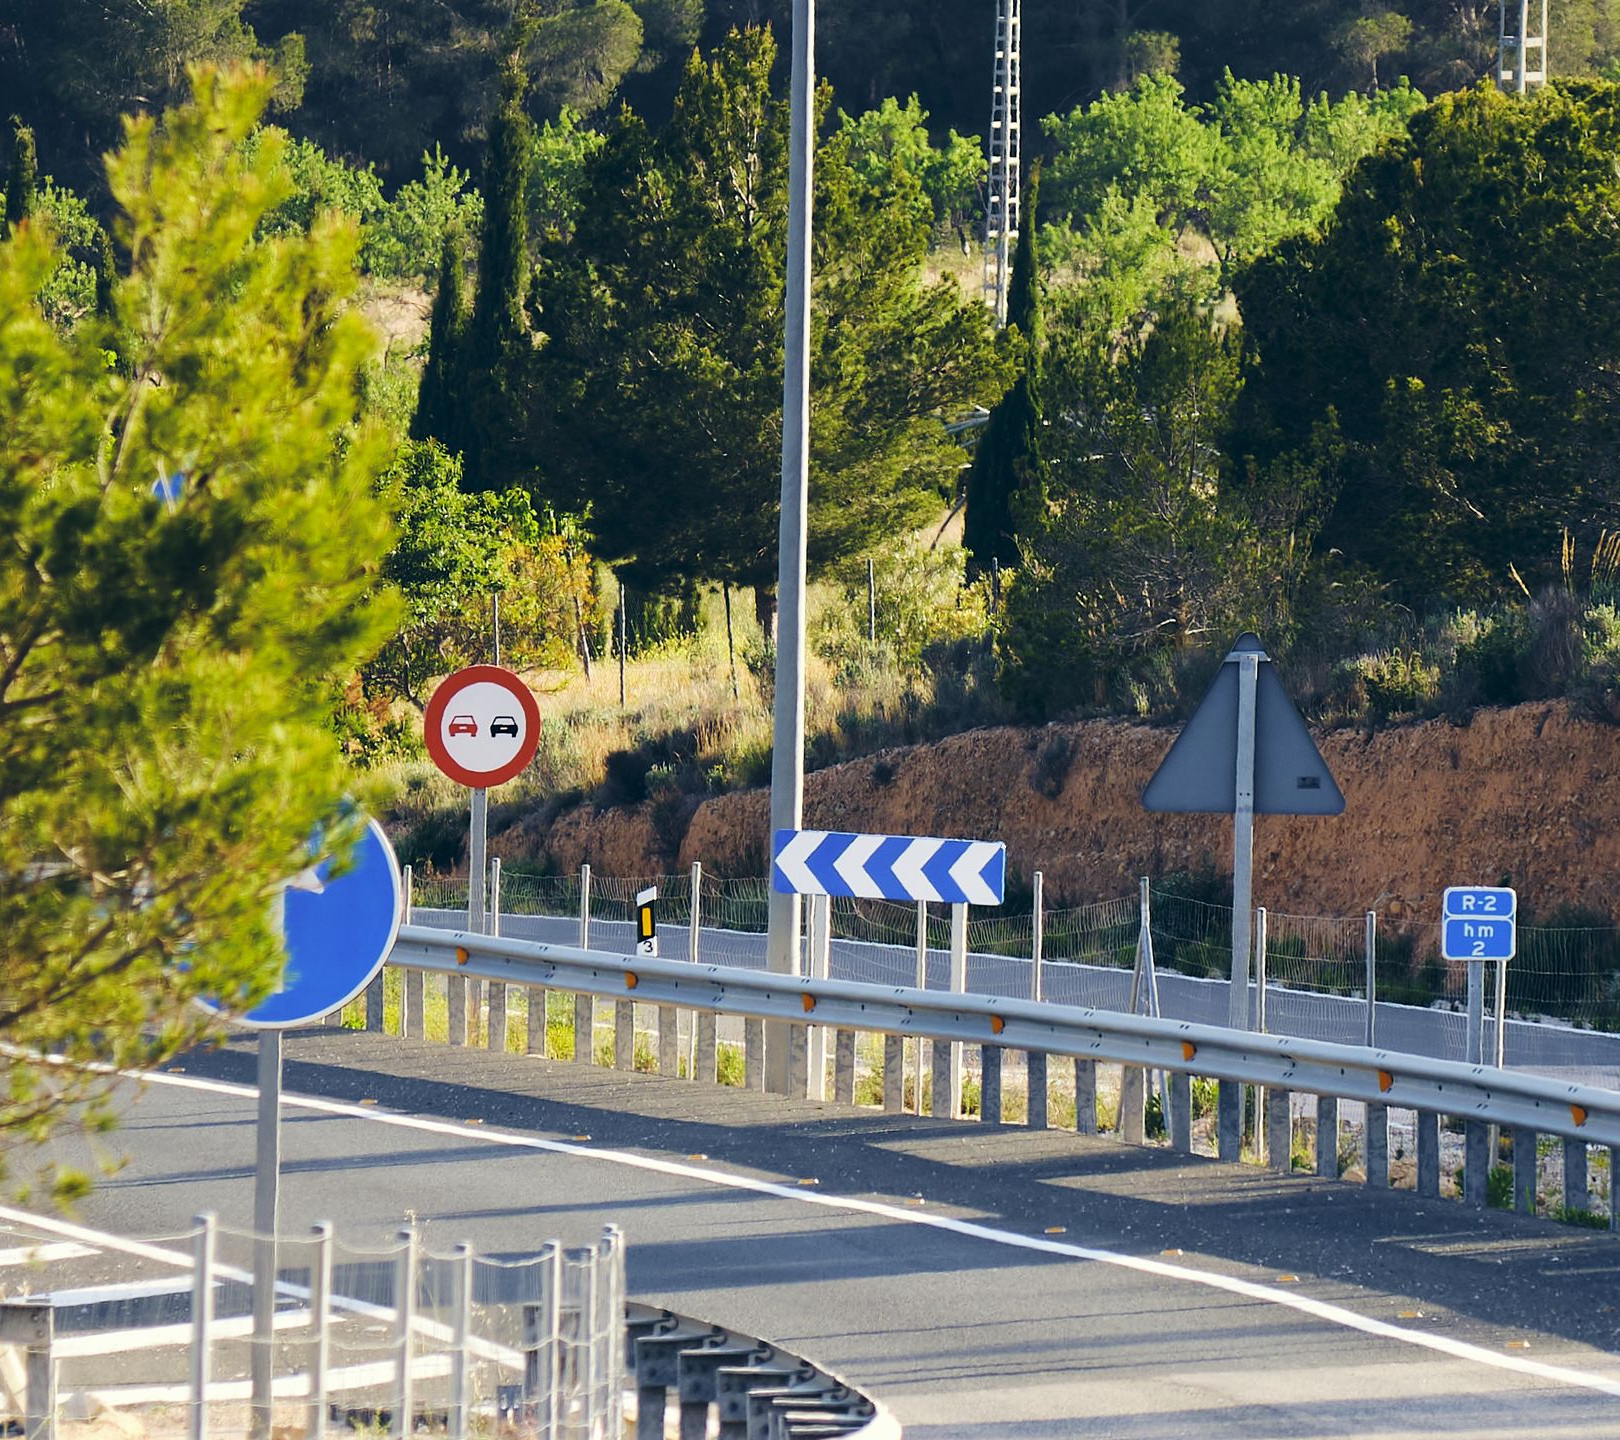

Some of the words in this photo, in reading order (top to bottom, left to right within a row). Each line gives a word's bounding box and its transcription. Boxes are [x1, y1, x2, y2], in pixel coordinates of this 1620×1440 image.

[1462, 895, 1497, 912] R-2
[643, 941, 654, 953] 3
[1471, 941, 1486, 956] 2
